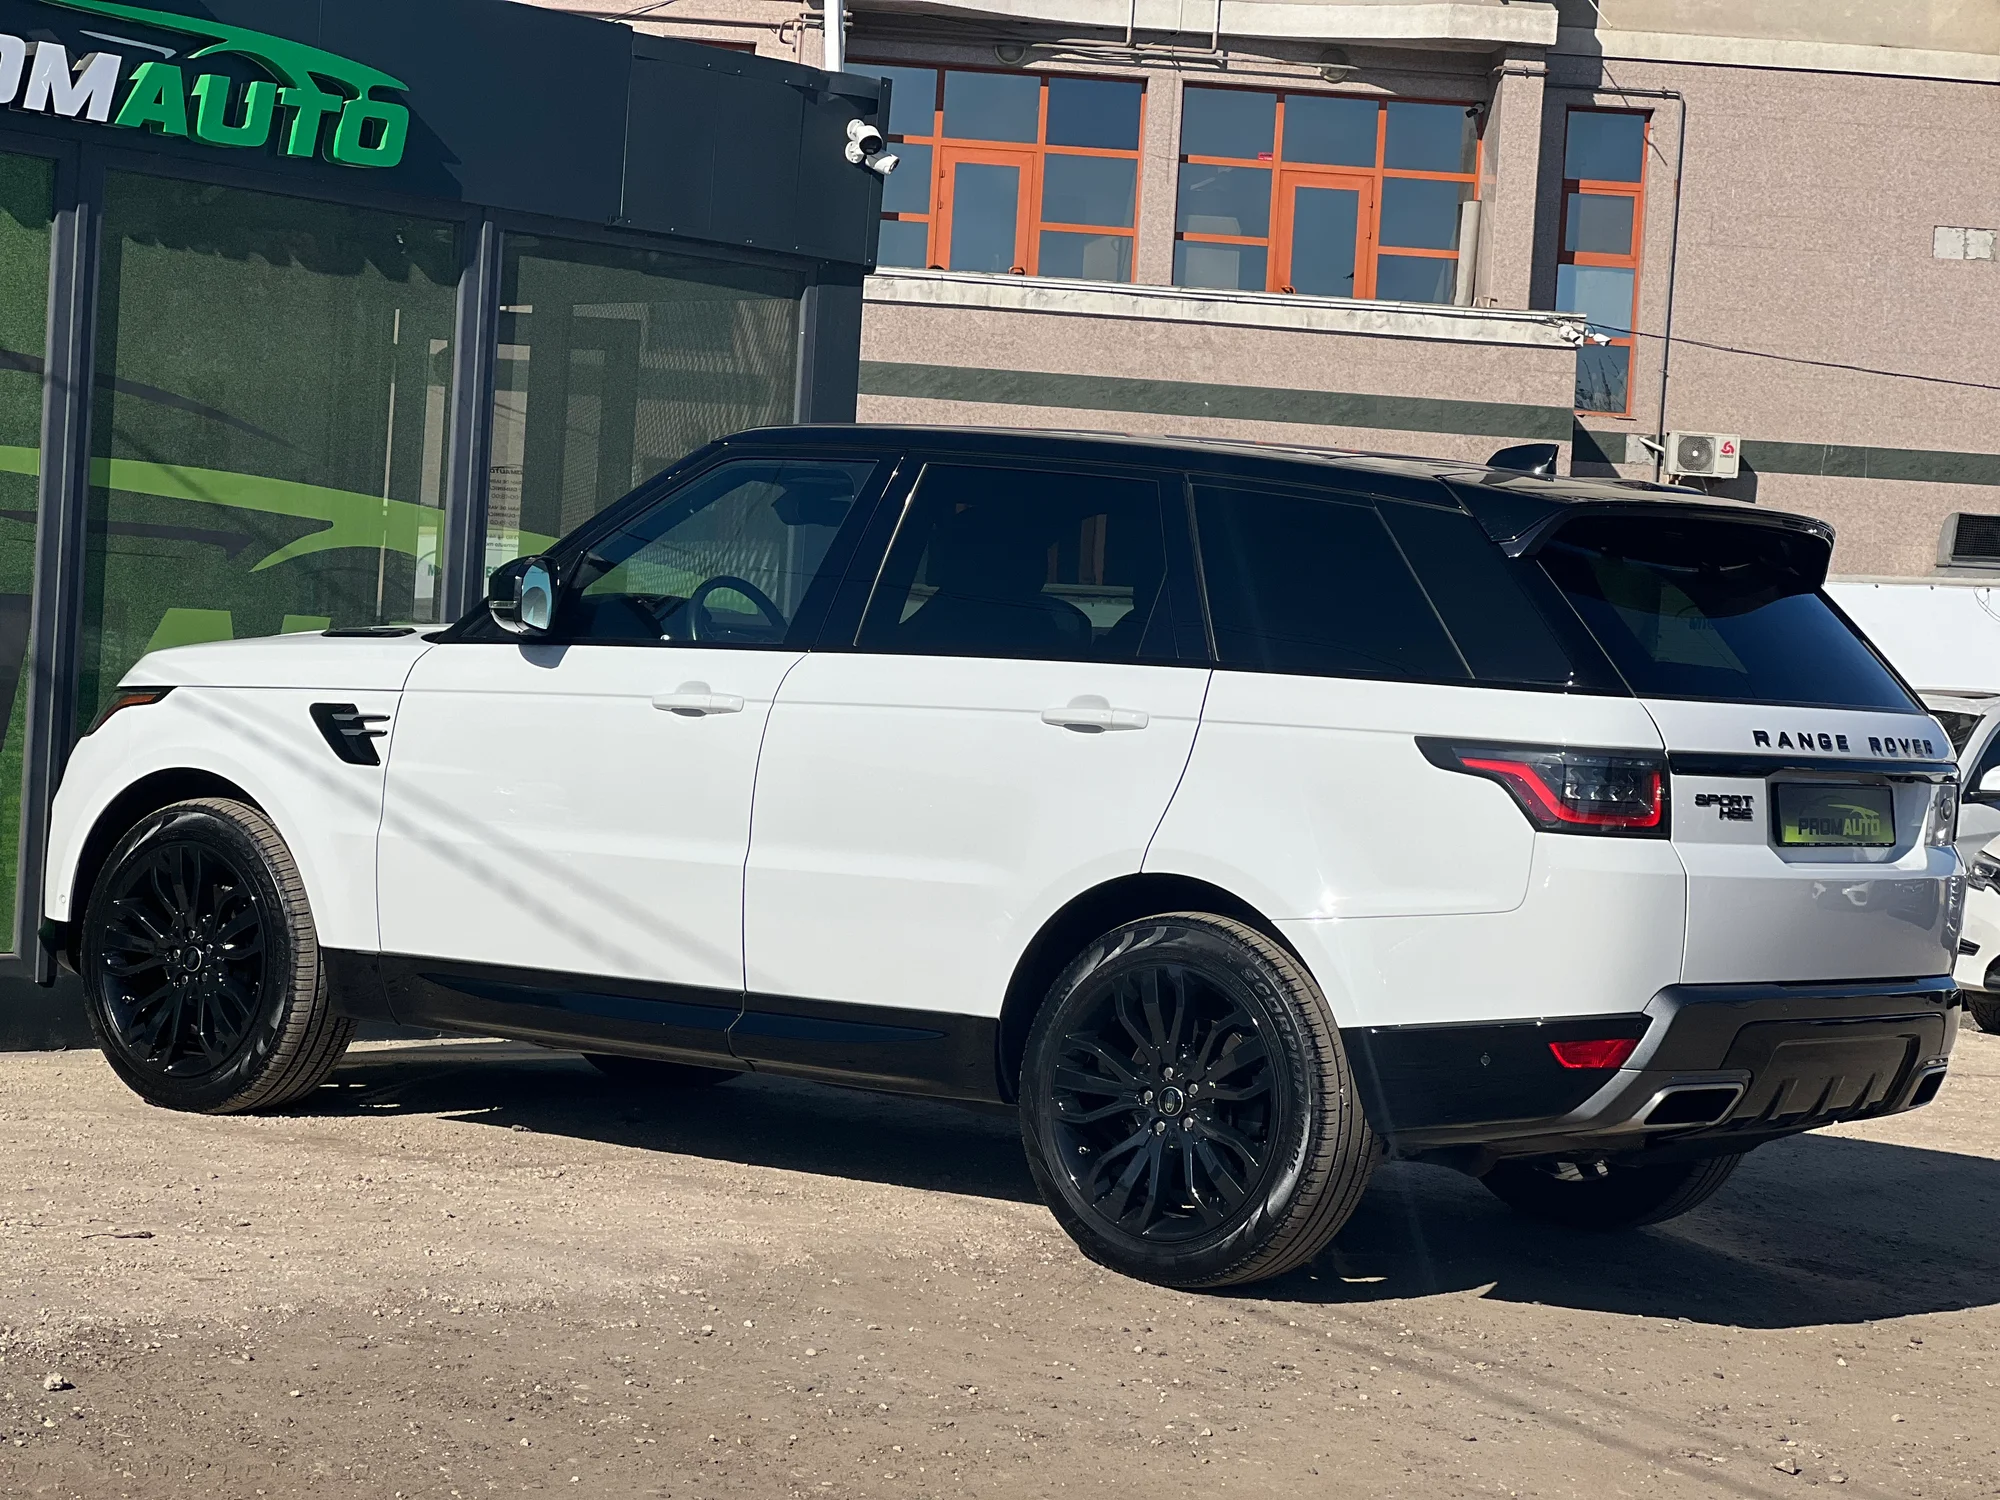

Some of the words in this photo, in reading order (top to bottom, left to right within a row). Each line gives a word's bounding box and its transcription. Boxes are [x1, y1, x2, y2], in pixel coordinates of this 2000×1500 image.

[1752, 730, 1850, 752] RANGE
[1868, 736, 1934, 757] ROVER
[1695, 794, 1754, 808] SPORT
[1719, 806, 1753, 821] HSE
[1797, 817, 1880, 836] PROMAUTO
